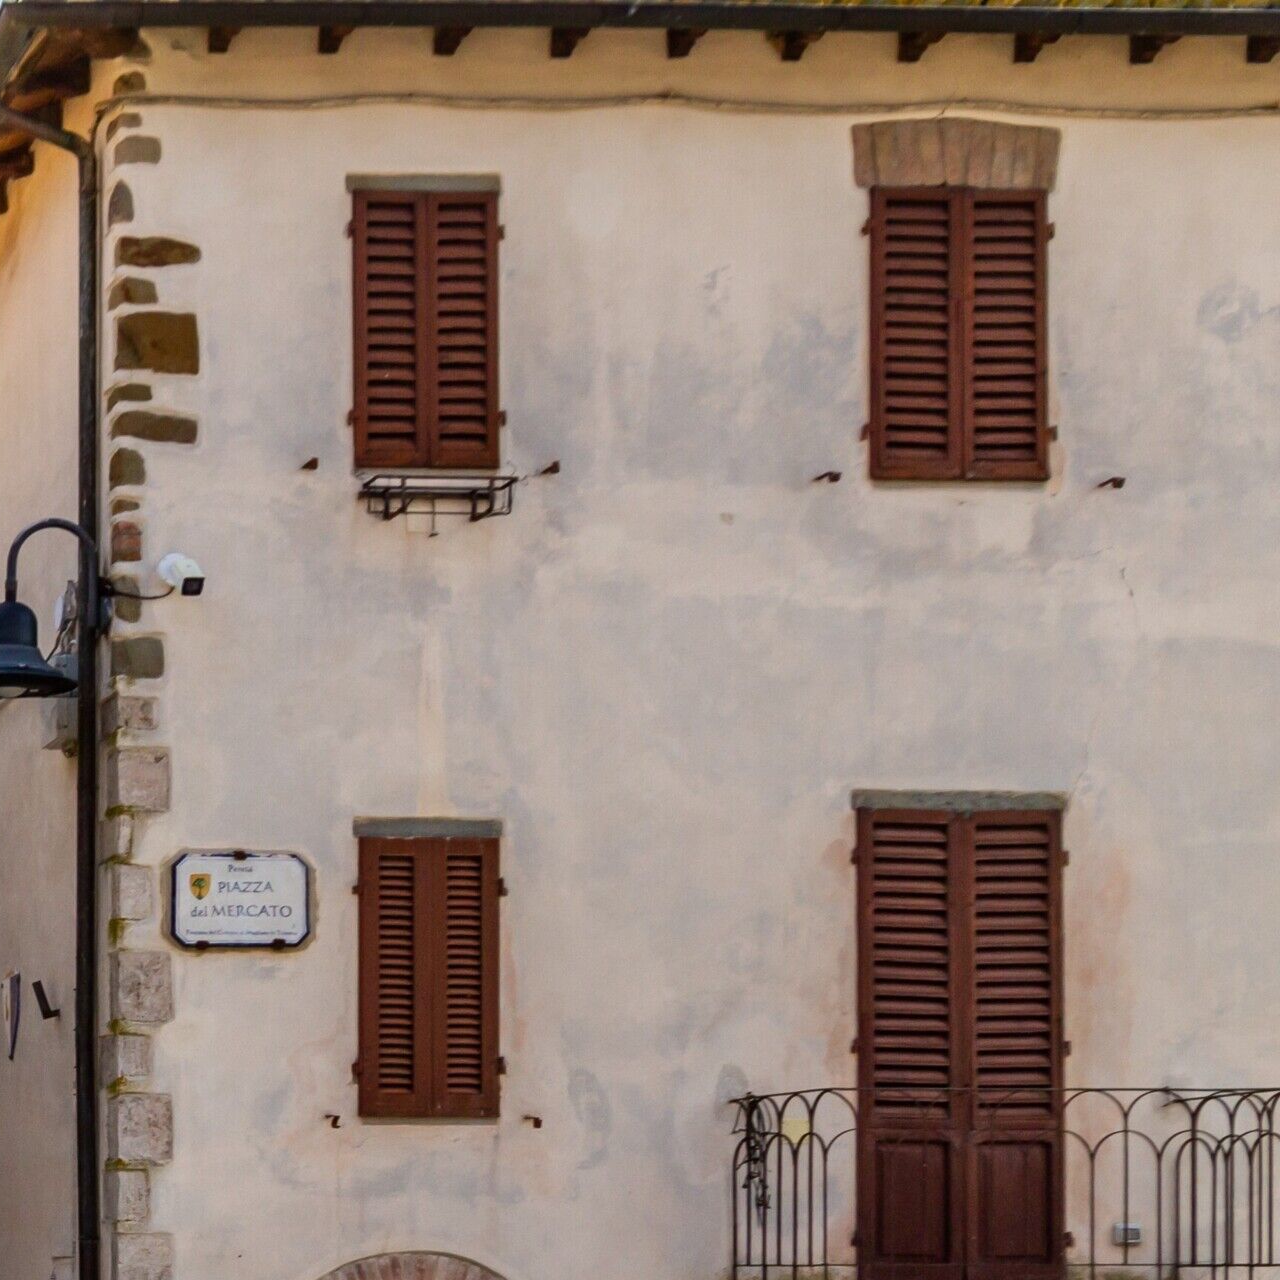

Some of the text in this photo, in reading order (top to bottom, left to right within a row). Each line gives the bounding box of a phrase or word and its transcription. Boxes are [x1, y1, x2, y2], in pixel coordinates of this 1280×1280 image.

[217, 881, 273, 893] PIAZZA
[190, 904, 292, 917] del MERCATO
